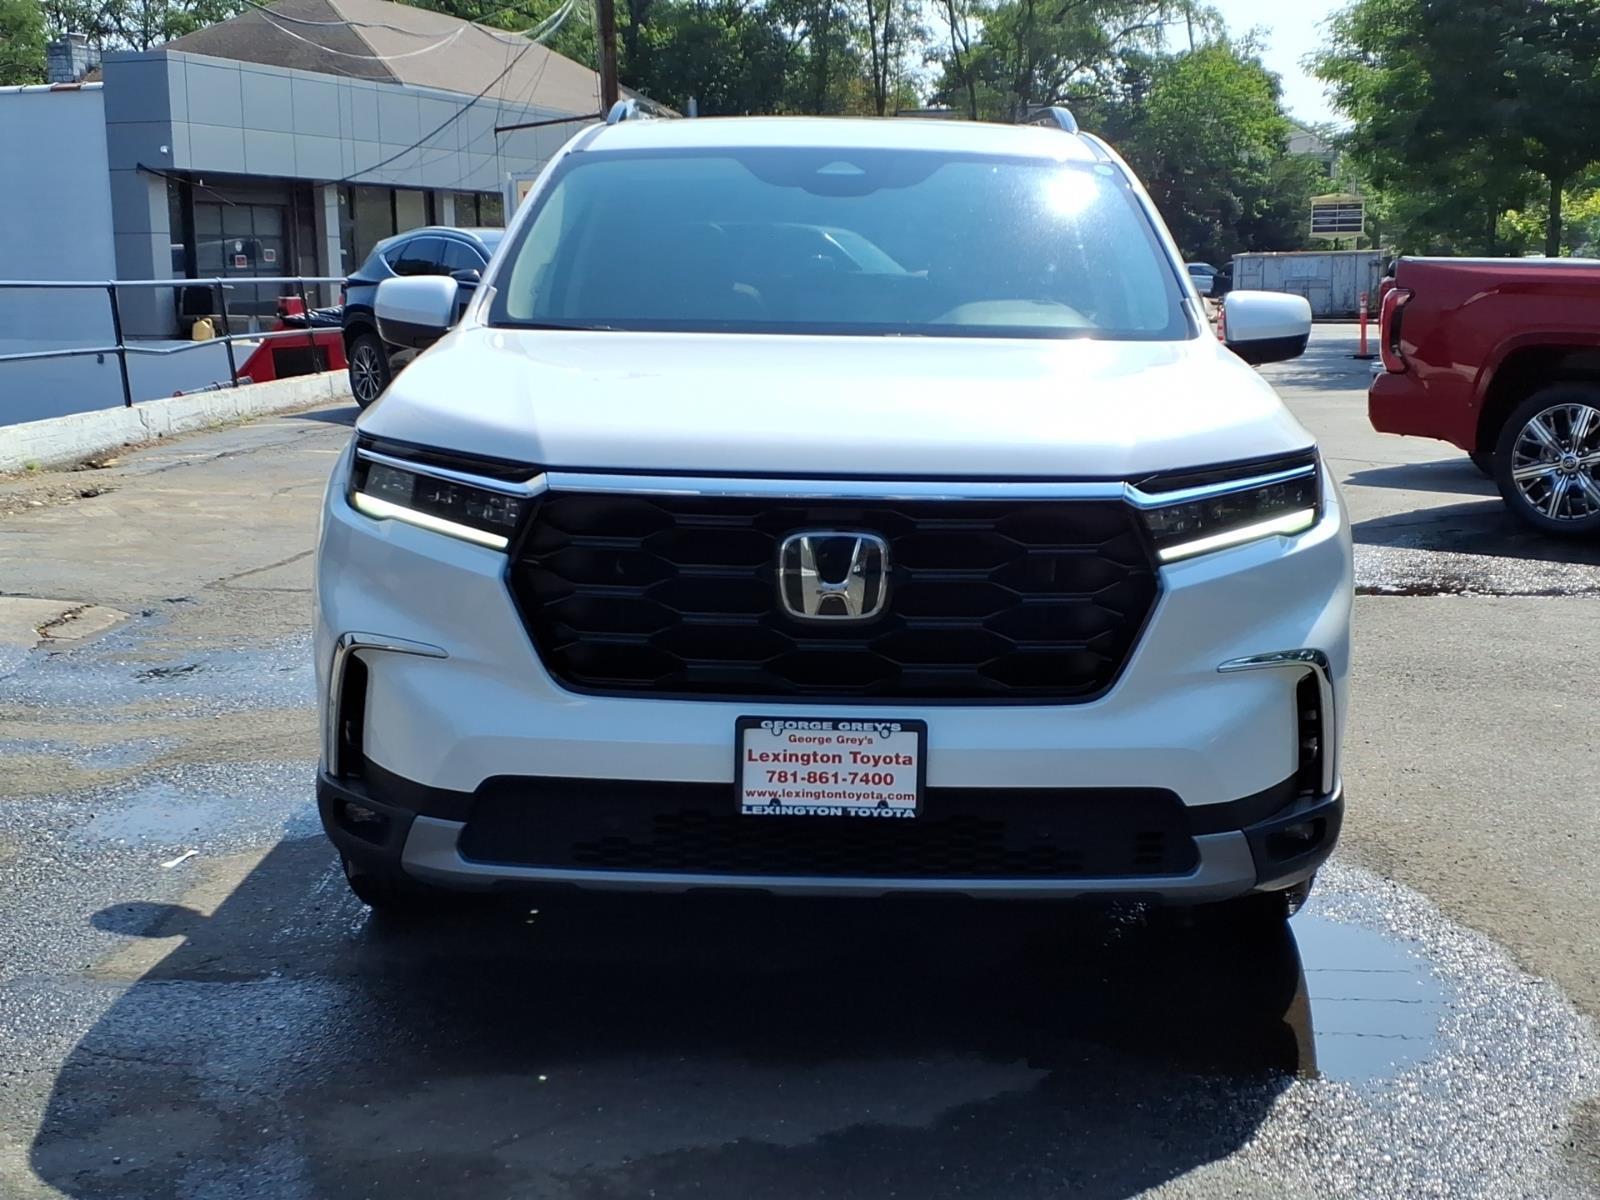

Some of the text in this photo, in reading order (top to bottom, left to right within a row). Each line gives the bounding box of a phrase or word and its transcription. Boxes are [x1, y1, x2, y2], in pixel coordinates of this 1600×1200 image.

[760, 720, 902, 732] GEORGE GREY'S
[788, 734, 874, 746] George Grey's
[747, 749, 913, 768] Lexington Toyota
[766, 770, 895, 786] 781-861-7400
[745, 788, 915, 801] www.lexingtontoyota.com
[742, 805, 916, 818] LEXINGTON TOYOTA
